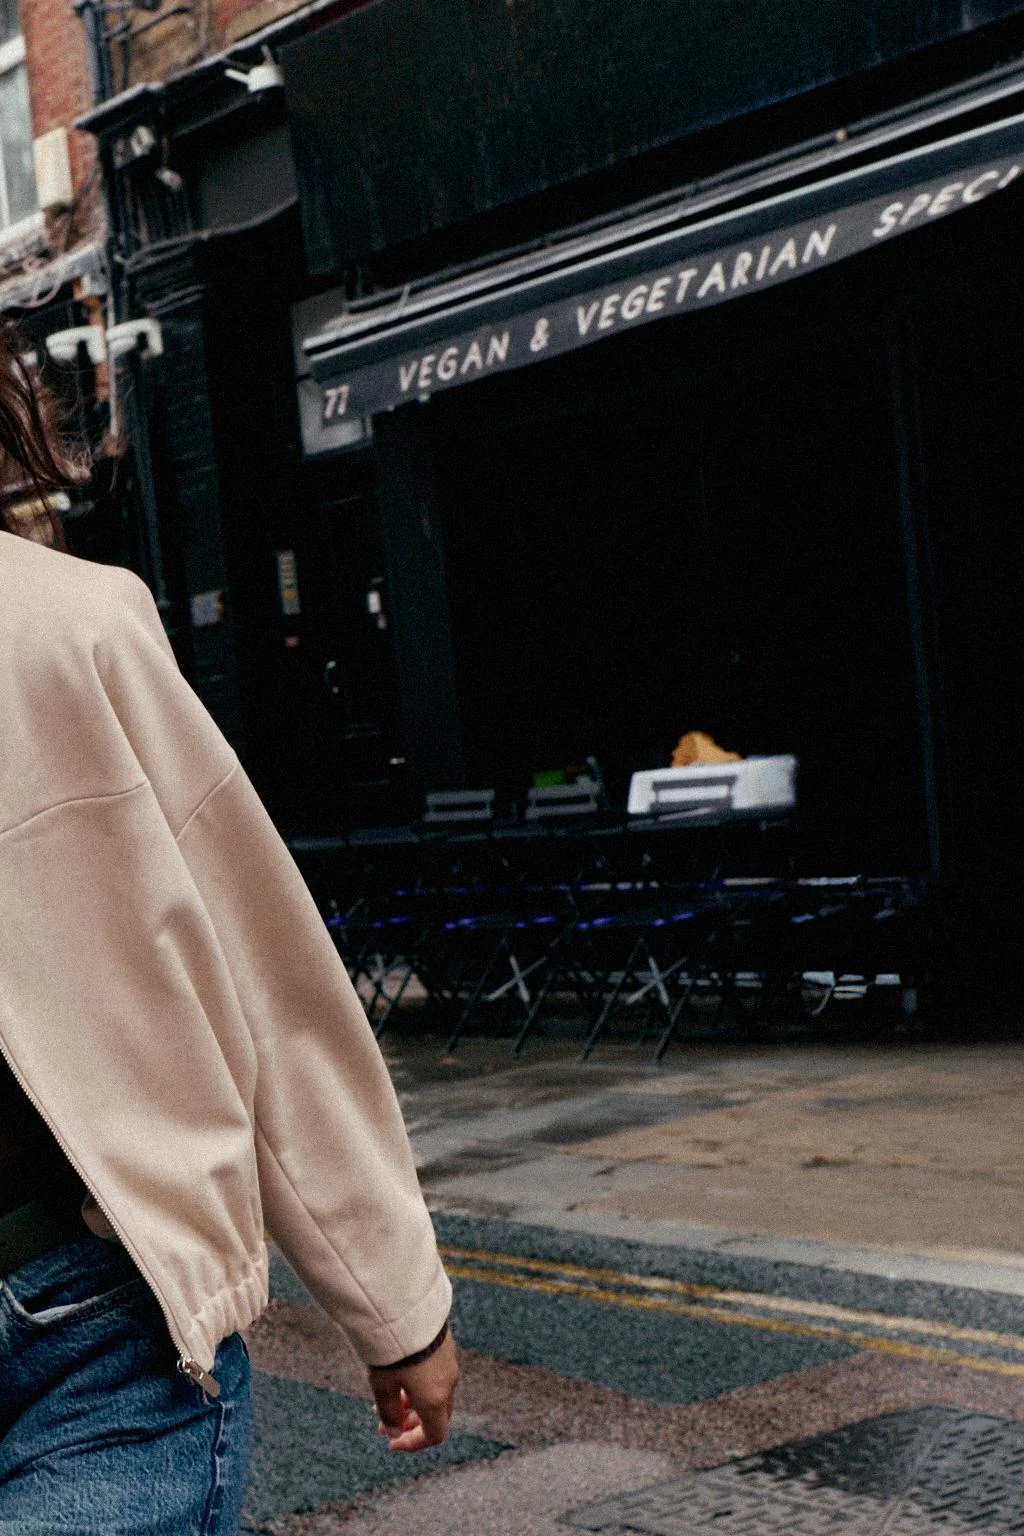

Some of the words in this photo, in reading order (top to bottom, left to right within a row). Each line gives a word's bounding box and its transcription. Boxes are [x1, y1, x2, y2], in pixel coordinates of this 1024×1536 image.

[324, 384, 350, 419] 77
[398, 333, 510, 392] VEGAN
[530, 318, 550, 353] &
[576, 225, 837, 337] VEGETARIAN
